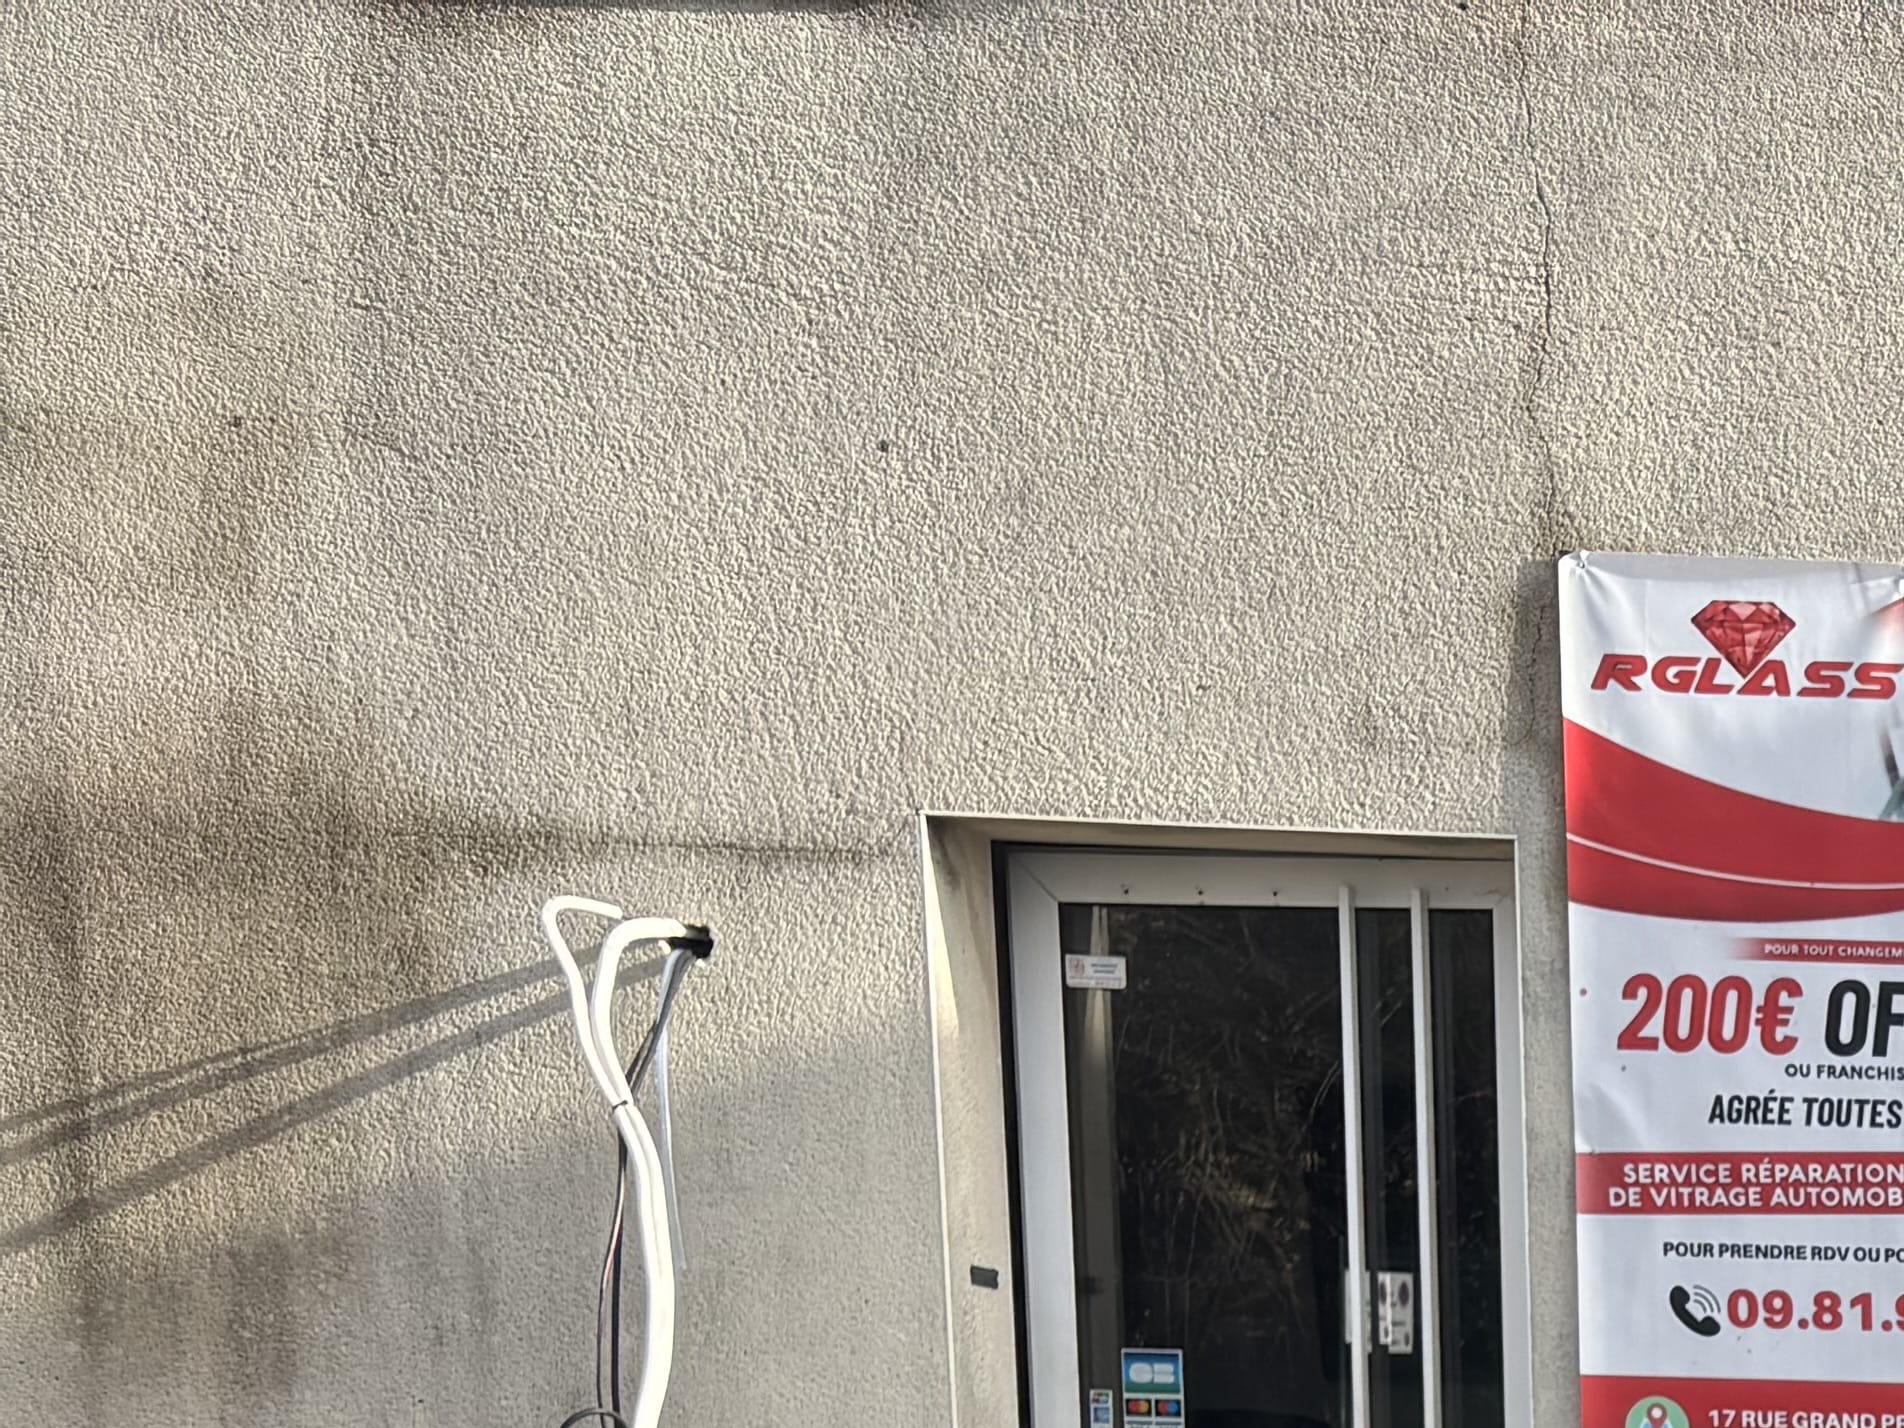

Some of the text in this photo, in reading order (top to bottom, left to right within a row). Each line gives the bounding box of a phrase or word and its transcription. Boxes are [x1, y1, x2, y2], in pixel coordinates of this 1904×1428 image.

[1590, 653, 1904, 700] RGLASS
[1764, 943, 1799, 956] POUR
[1803, 944, 1835, 957] TOUT
[1617, 973, 1803, 1056] 200€
[1784, 1064, 1810, 1079] OU
[1708, 1089, 1795, 1126] AGRÉE
[1802, 1097, 1903, 1129] TOUTES
[1623, 1163, 1732, 1184] SERVICE
[1608, 1187, 1642, 1207] DE
[1649, 1187, 1762, 1207] VITRAGE
[1663, 1241, 1715, 1258] POUR
[1718, 1243, 1808, 1260] PRENDRE
[1810, 1245, 1850, 1262] RDV
[1853, 1246, 1881, 1263] OU
[1707, 1409, 1736, 1428] 17
